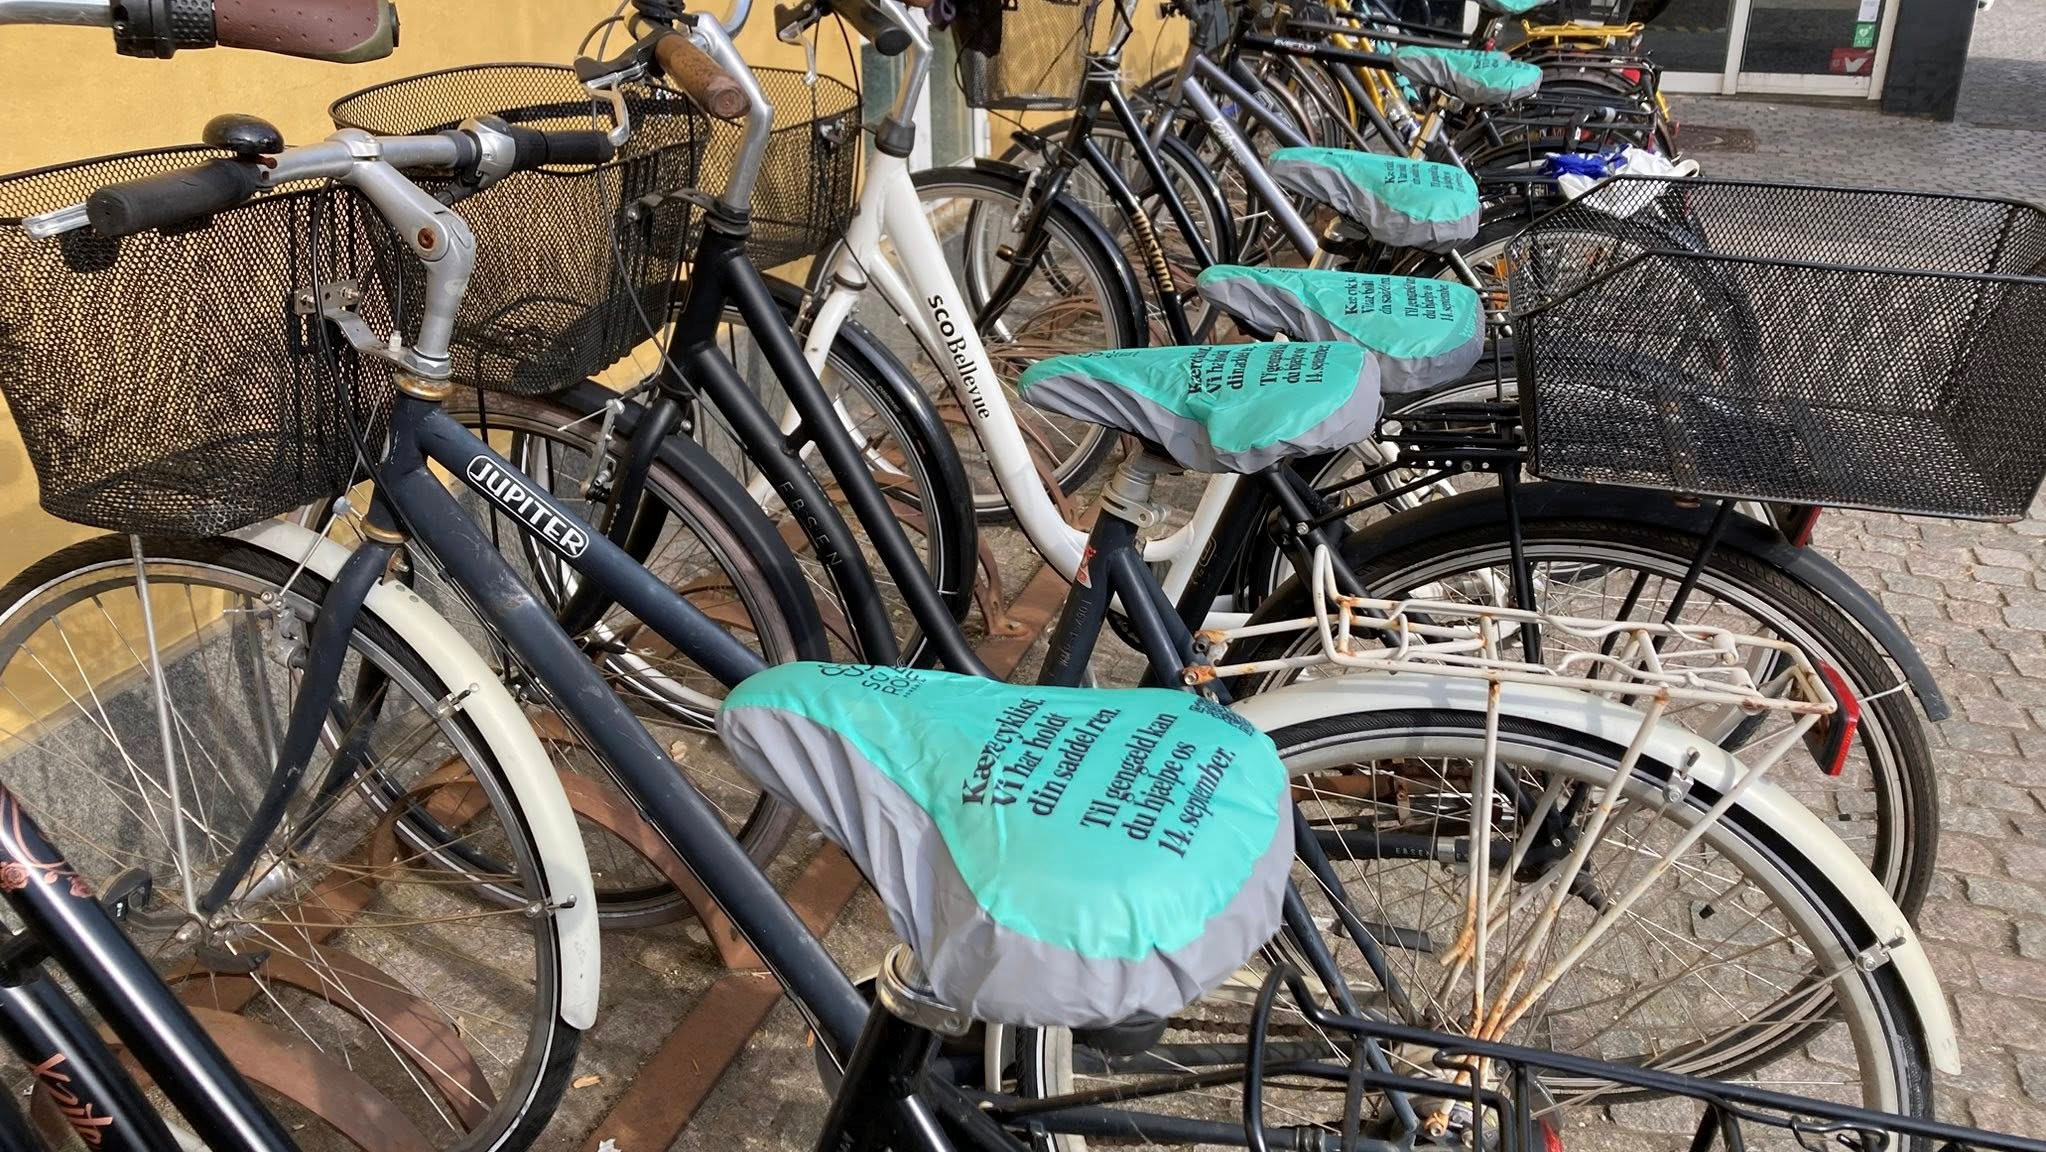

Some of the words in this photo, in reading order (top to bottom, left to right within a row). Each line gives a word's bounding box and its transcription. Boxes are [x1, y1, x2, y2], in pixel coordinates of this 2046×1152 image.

[947, 336, 990, 419] Bellevue
[469, 462, 585, 555] JUPITER
[778, 481, 842, 566] EBSEN
[1022, 711, 1072, 751] holdt
[1171, 741, 1196, 760] os
[962, 740, 1006, 805] Kære
[991, 779, 1024, 805] Vi
[1002, 750, 1043, 778] har
[1027, 780, 1067, 816] din
[1054, 727, 1100, 781] saddel
[1079, 799, 1121, 828] Til
[1105, 735, 1159, 803] gengæld
[1136, 713, 1179, 739] kan
[1133, 760, 1186, 813] hjælpe
[1121, 813, 1157, 841] du
[1158, 829, 1195, 859] 14.
[1179, 746, 1236, 829] september.
